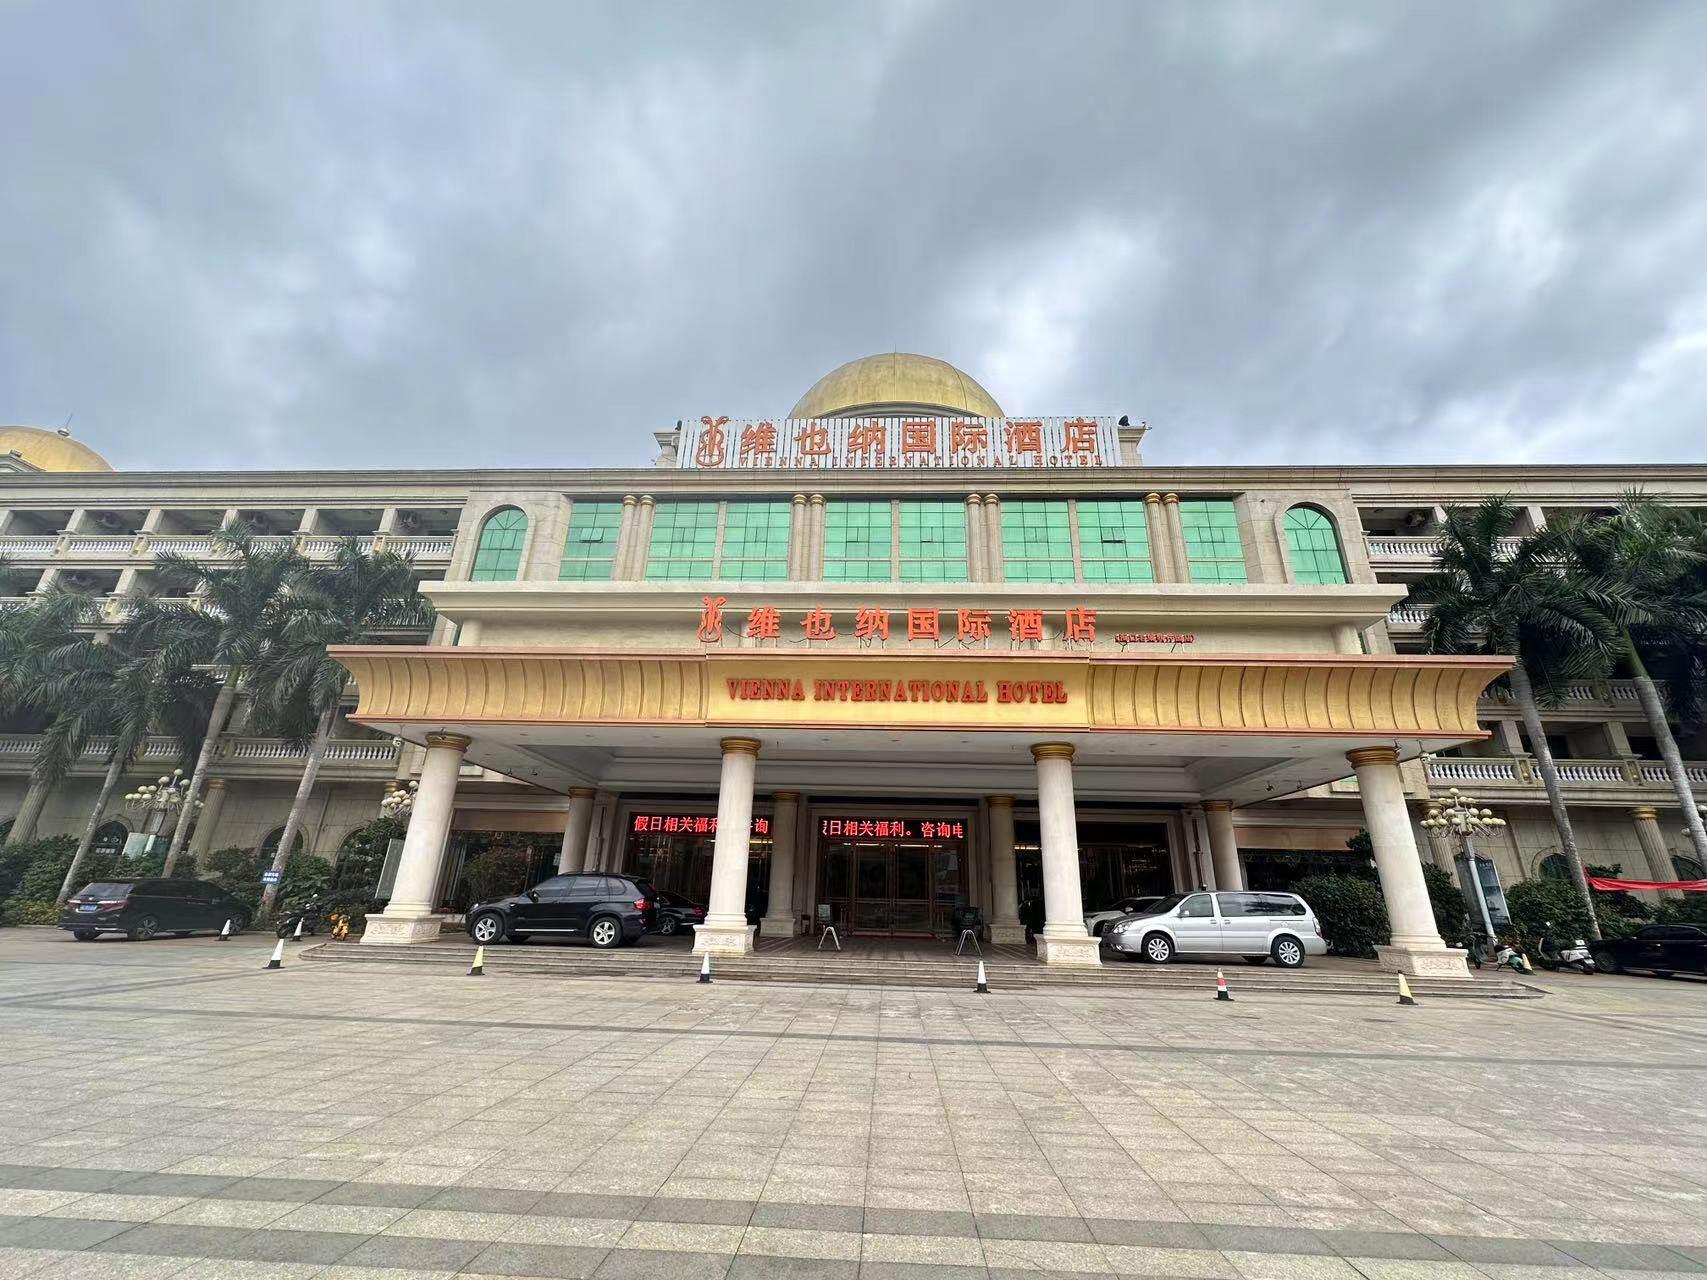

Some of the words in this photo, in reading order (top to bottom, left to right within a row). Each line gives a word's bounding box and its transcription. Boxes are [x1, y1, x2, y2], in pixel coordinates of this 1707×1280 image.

[740, 417, 1098, 455] 维也纳国际酒店
[740, 456, 819, 467] VIENNA
[833, 455, 1017, 467] INTERNATIONAL
[1034, 455, 1103, 466] HOTEL
[747, 605, 1097, 642] 维也纳国际酒店
[727, 678, 806, 701] VIENNA
[814, 679, 989, 703] INTERNATIONAL
[997, 680, 1068, 704] HOTEL
